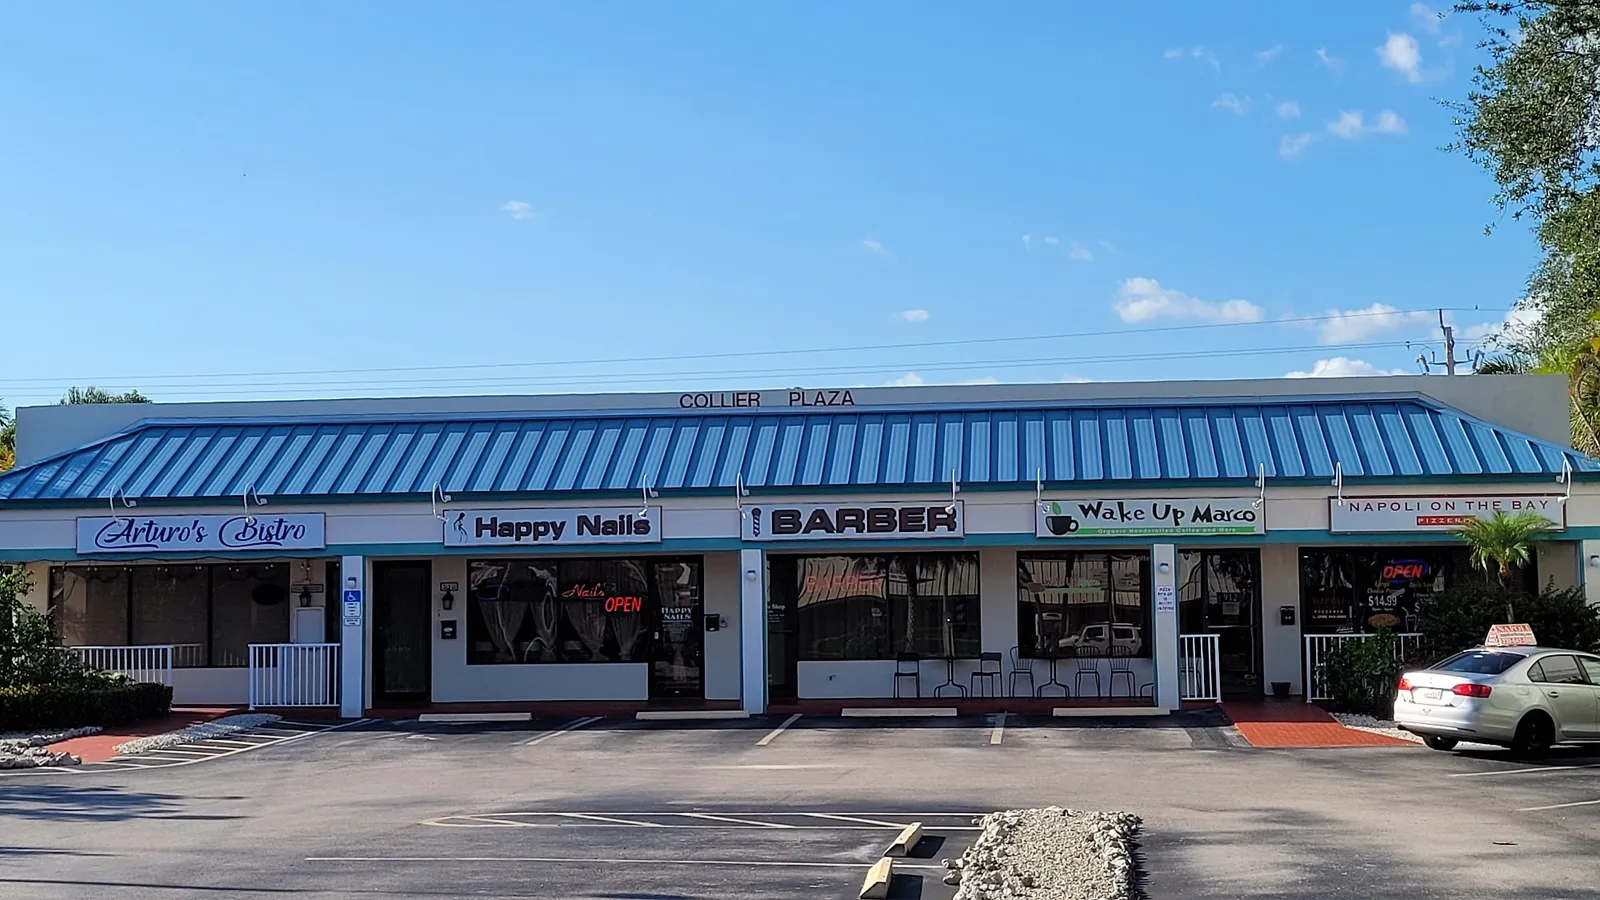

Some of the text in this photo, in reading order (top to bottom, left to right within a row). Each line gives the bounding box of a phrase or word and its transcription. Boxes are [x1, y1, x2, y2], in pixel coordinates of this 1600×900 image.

[679, 390, 855, 408] COLLIER PLAZA
[1078, 501, 1256, 526] Wake Up Marco
[1349, 500, 1549, 511] NAPOLI ON THE BAY
[475, 514, 651, 541] Happy Nails
[771, 507, 957, 534] BARBER
[94, 516, 306, 549] Arturo's Bistro
[1382, 565, 1423, 579] OPEN
[562, 582, 605, 598] Nails
[605, 597, 642, 612] OPEN
[1368, 595, 1397, 607] $14.99
